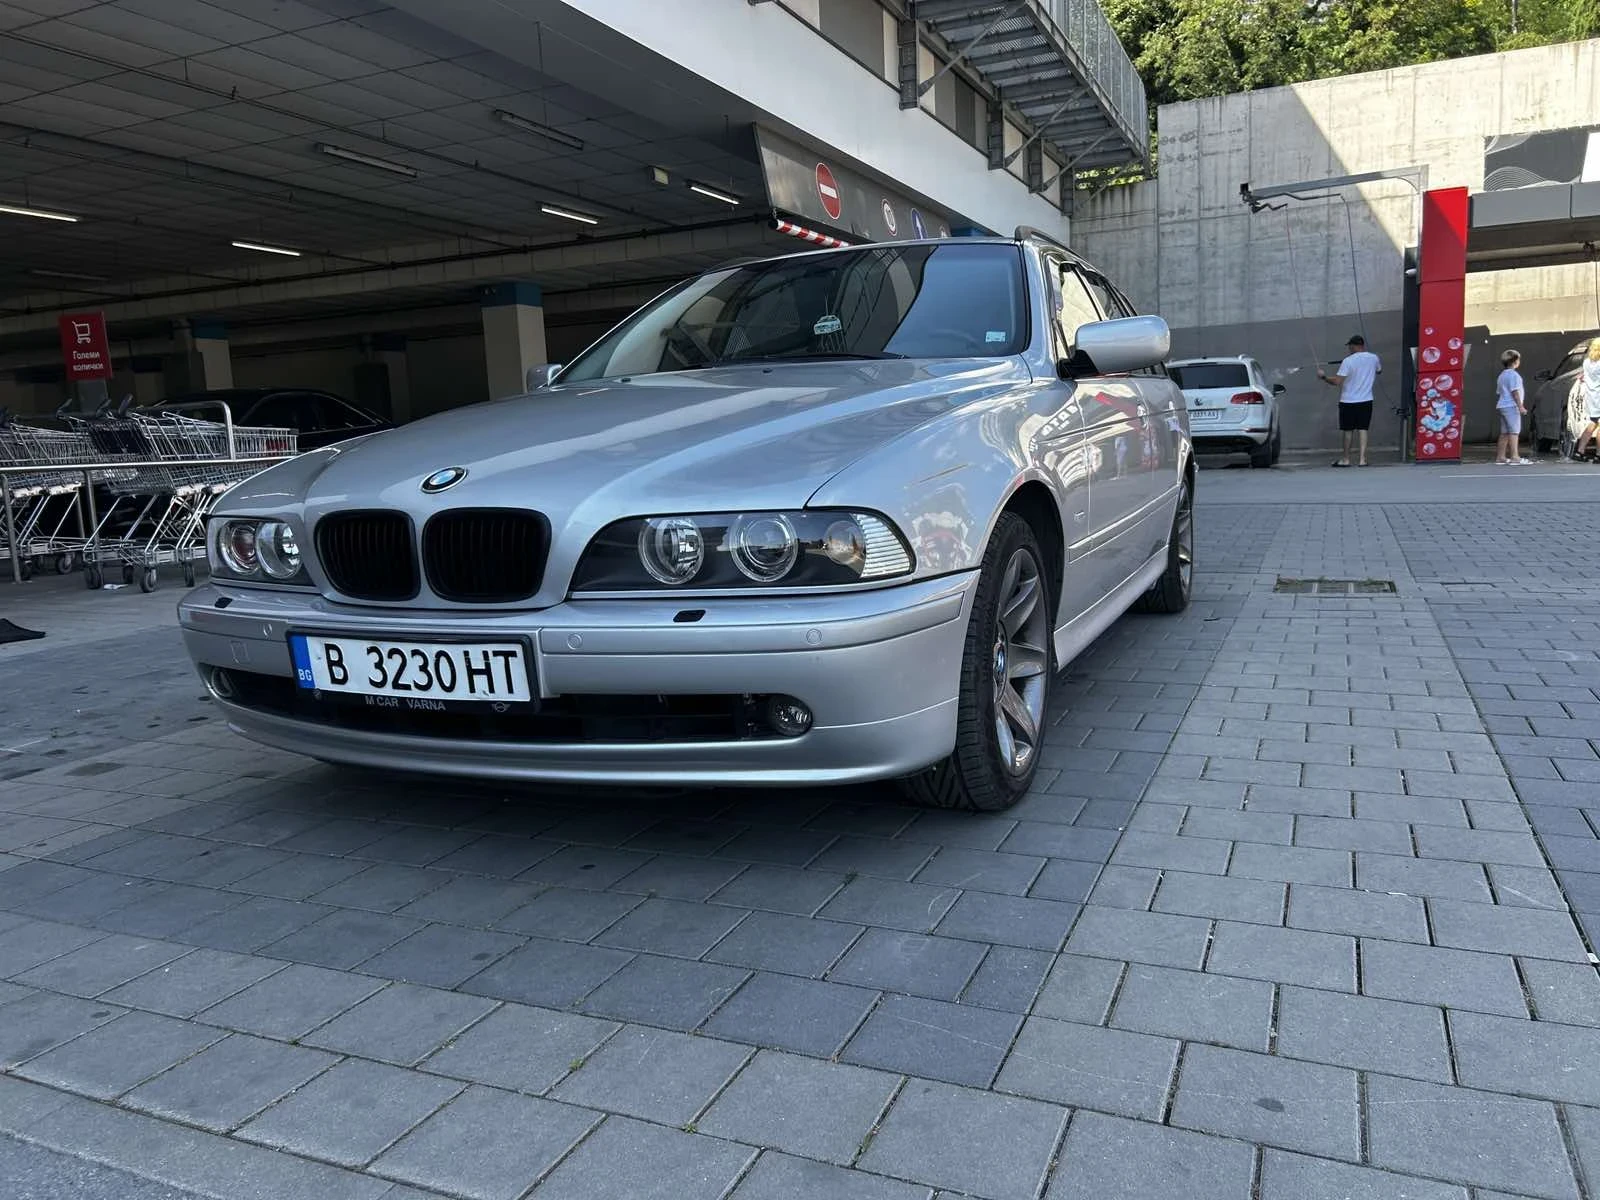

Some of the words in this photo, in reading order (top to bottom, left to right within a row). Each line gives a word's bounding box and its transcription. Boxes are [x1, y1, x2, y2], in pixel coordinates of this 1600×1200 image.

[298, 668, 313, 681] BG
[324, 643, 349, 685] B
[366, 645, 456, 693] 3230
[463, 650, 518, 694] HT
[364, 695, 375, 705] M
[376, 696, 399, 707] CAR
[406, 699, 446, 710] VARNA
